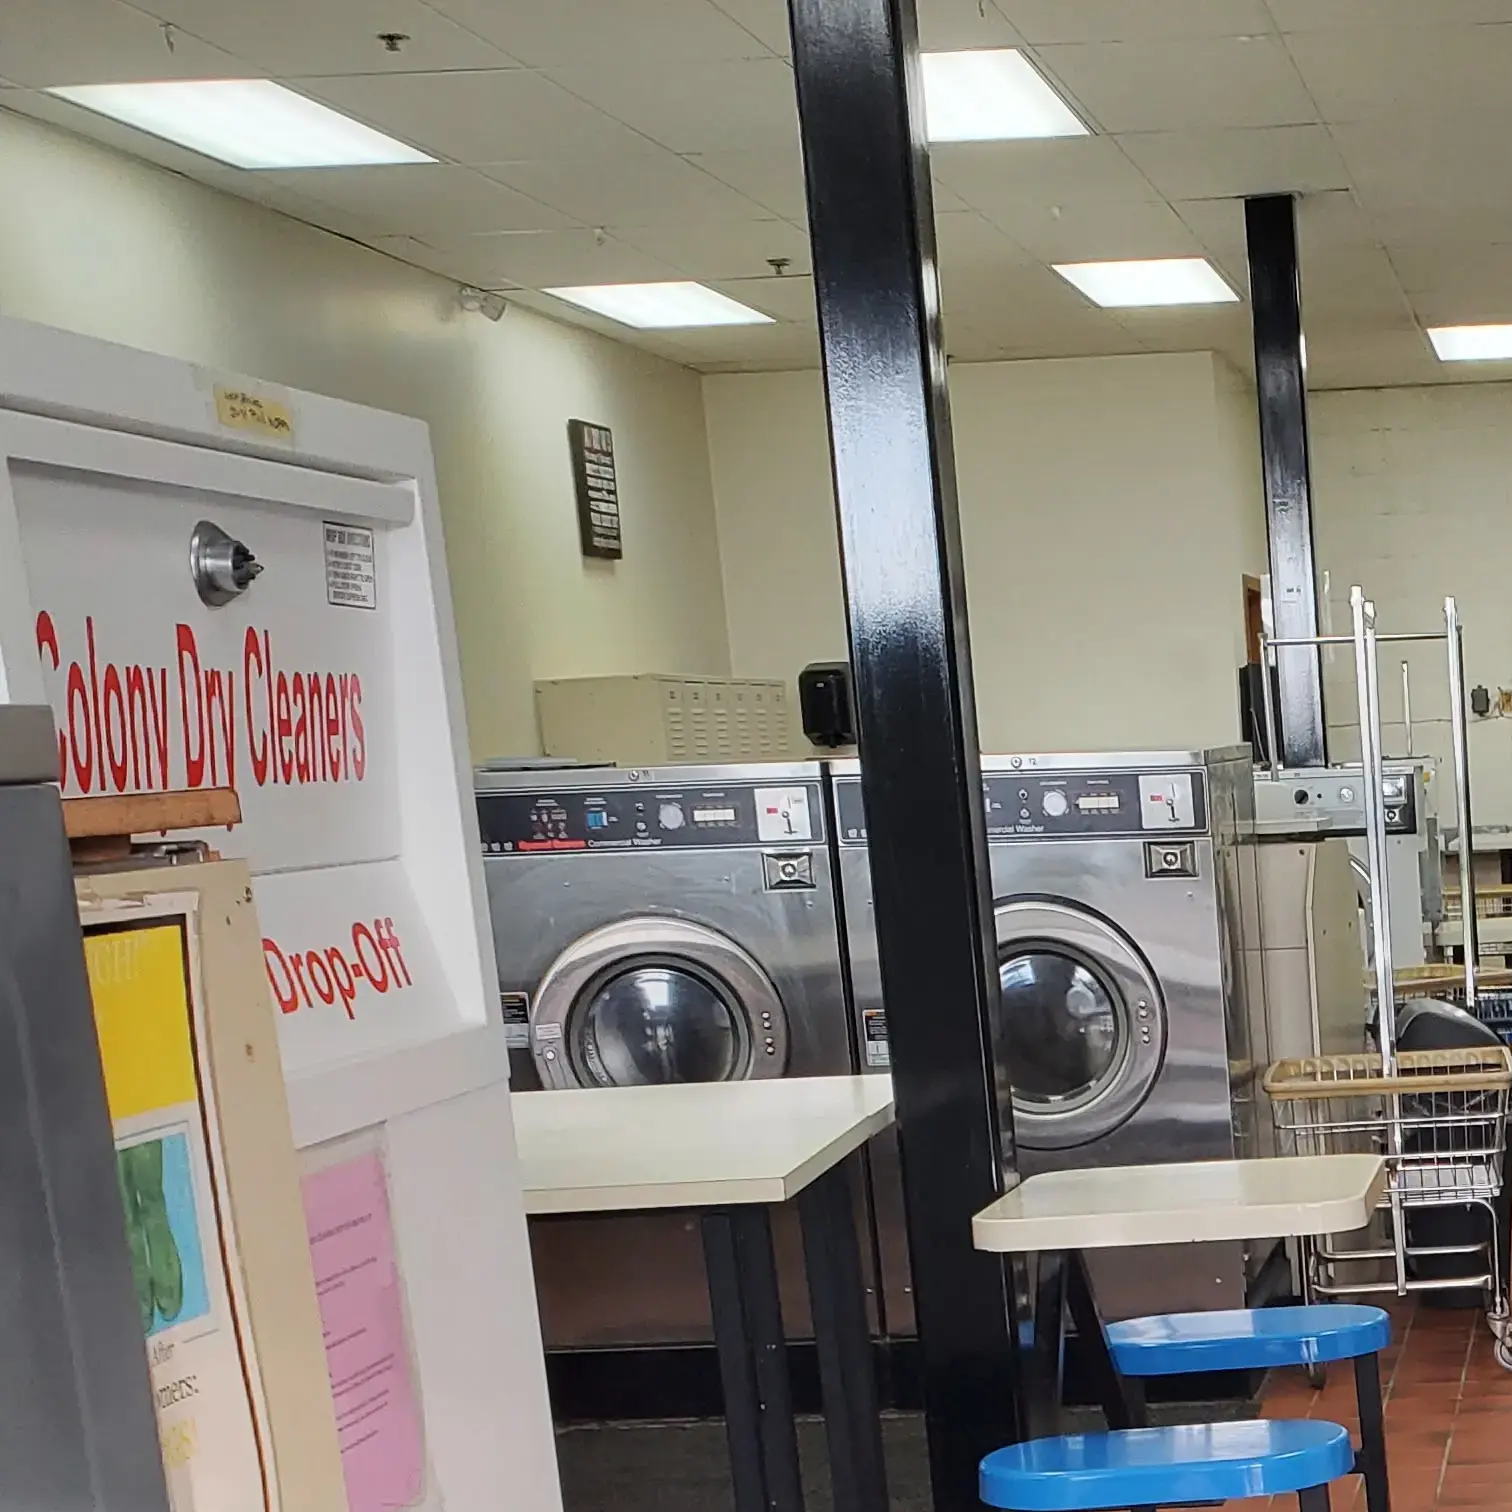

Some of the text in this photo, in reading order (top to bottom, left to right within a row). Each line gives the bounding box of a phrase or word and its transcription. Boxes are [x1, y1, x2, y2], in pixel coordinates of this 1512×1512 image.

[175, 623, 235, 832] Dry
[244, 626, 368, 787] Cleaners
[261, 917, 413, 1021] Drop-Off
